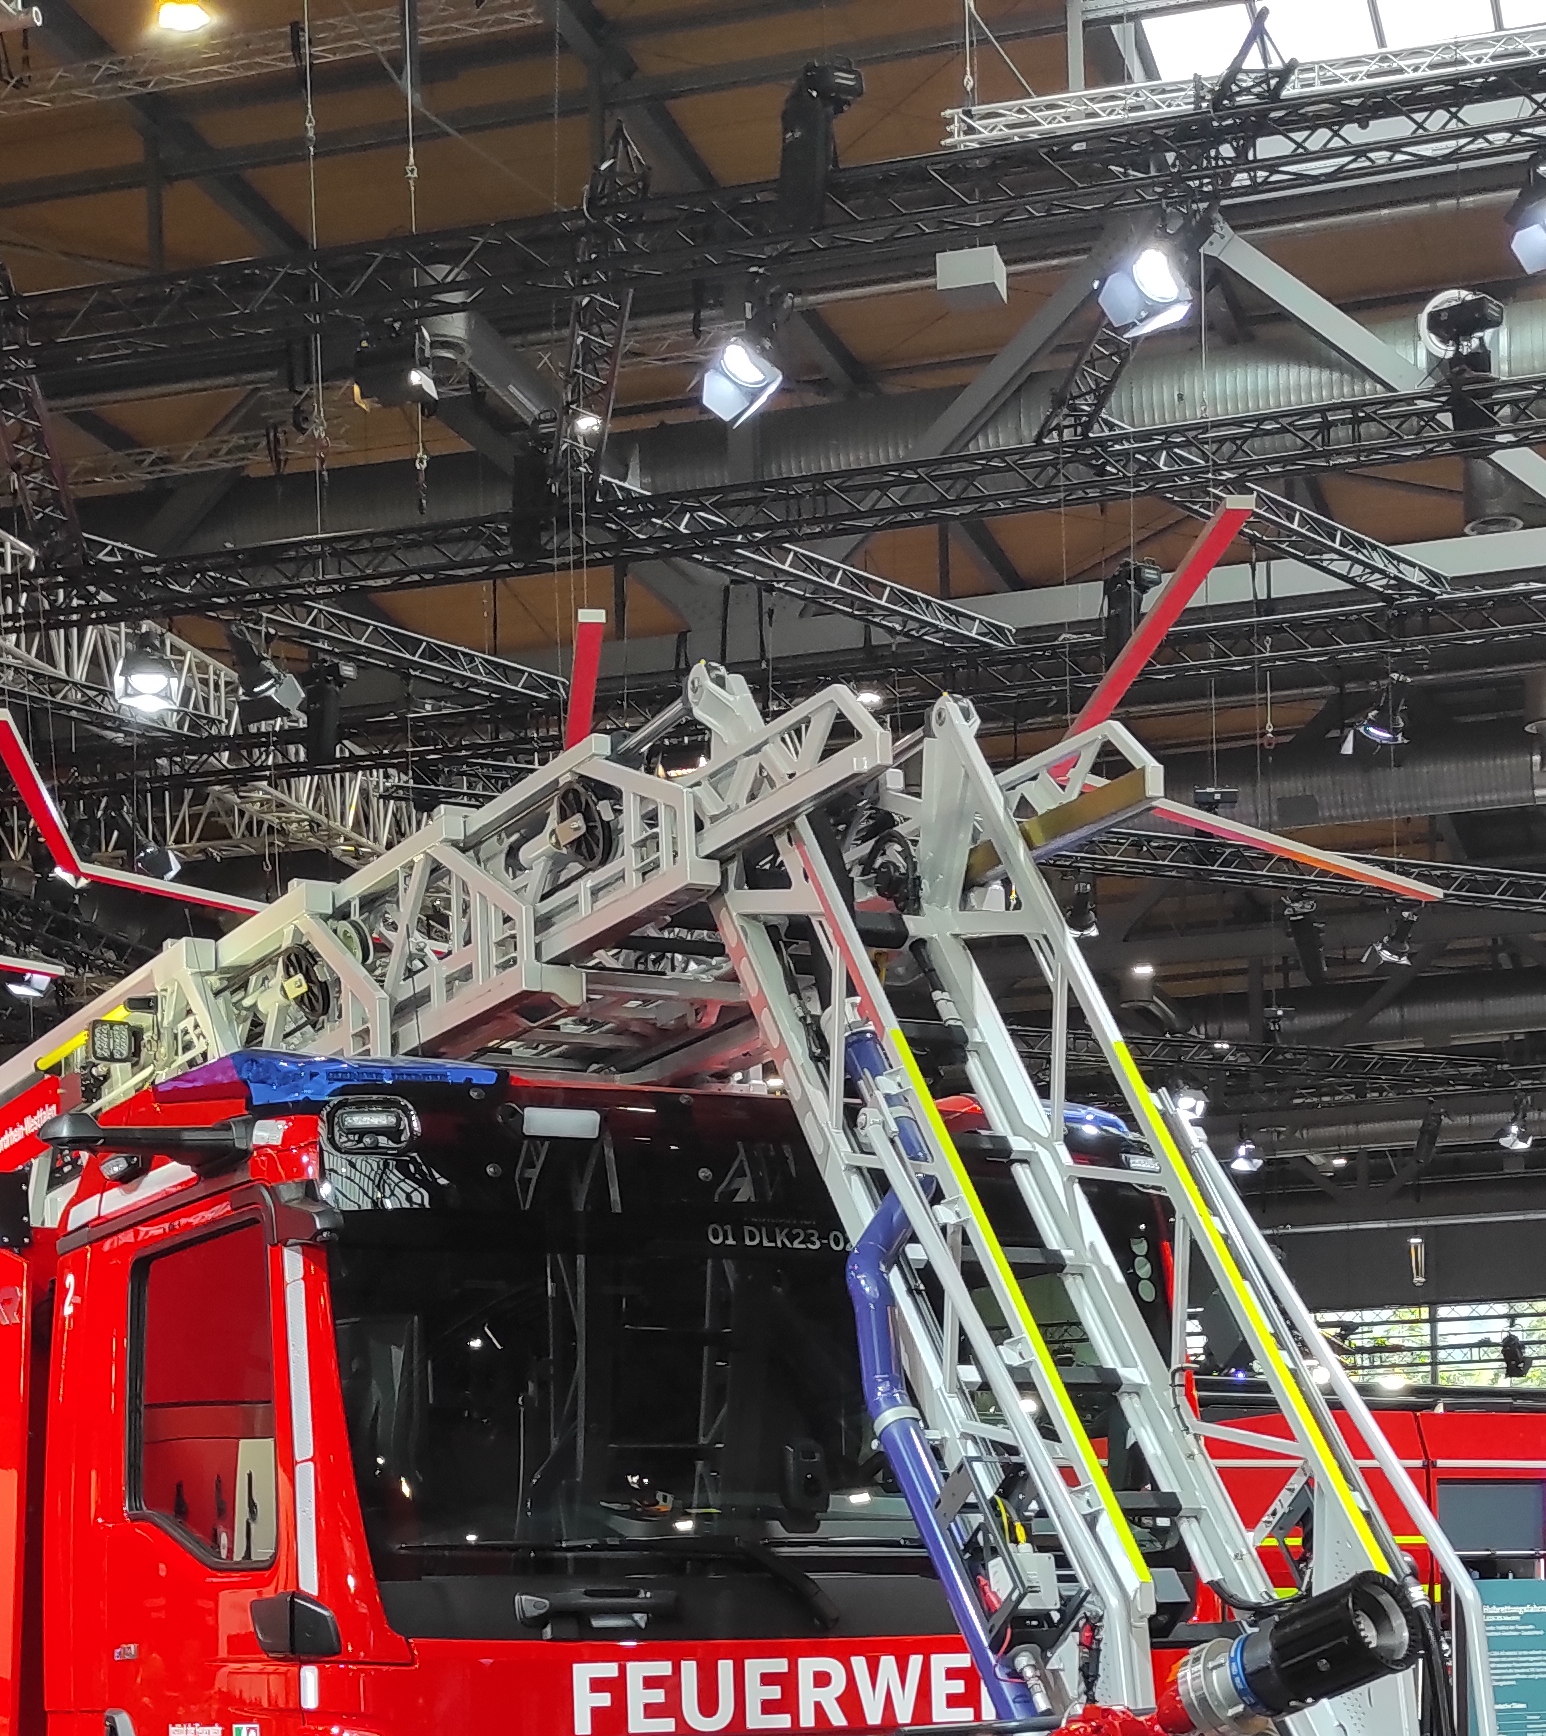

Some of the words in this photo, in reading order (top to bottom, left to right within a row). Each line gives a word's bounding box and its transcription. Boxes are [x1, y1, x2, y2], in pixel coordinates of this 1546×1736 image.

[707, 1223, 737, 1246] 01
[63, 1273, 75, 1317] 2
[572, 1652, 998, 1736] FEUERWE
